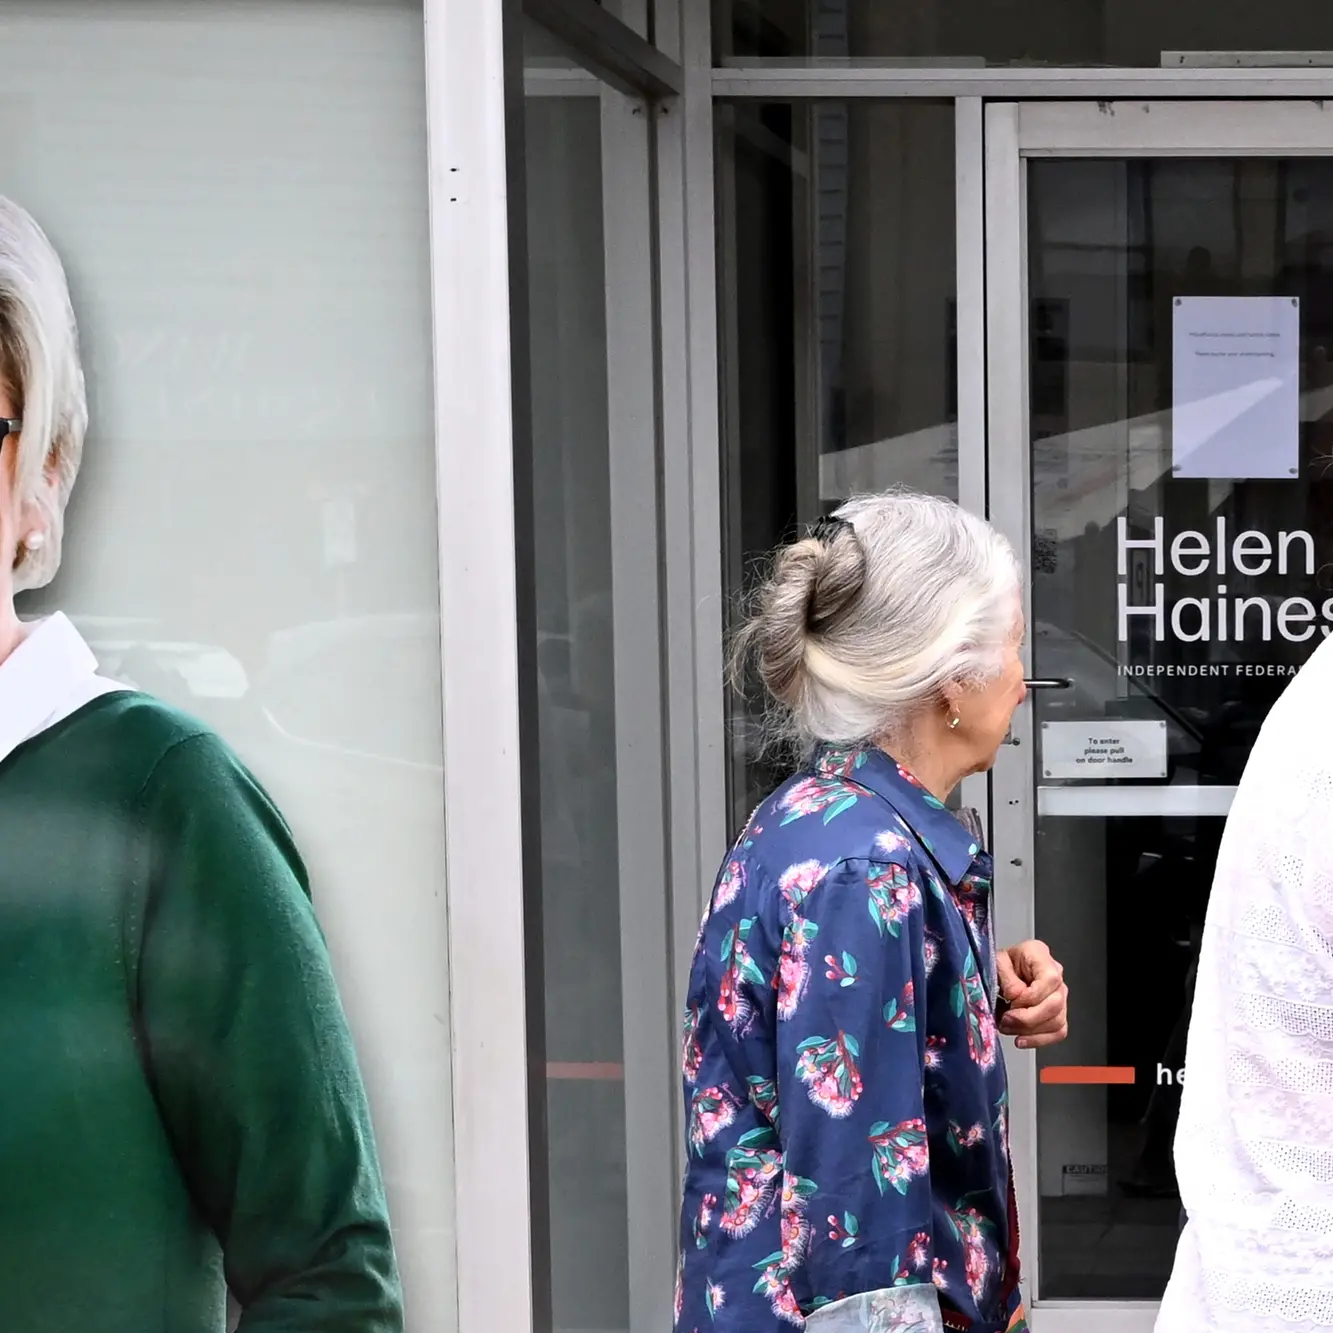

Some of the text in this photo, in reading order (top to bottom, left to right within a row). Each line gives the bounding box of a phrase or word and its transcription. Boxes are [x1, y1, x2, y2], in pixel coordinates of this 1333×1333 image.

[1117, 516, 1315, 576] Helen
[1118, 665, 1302, 676] INDEPENDENT FEDERA
[1084, 747, 1124, 755] please pull
